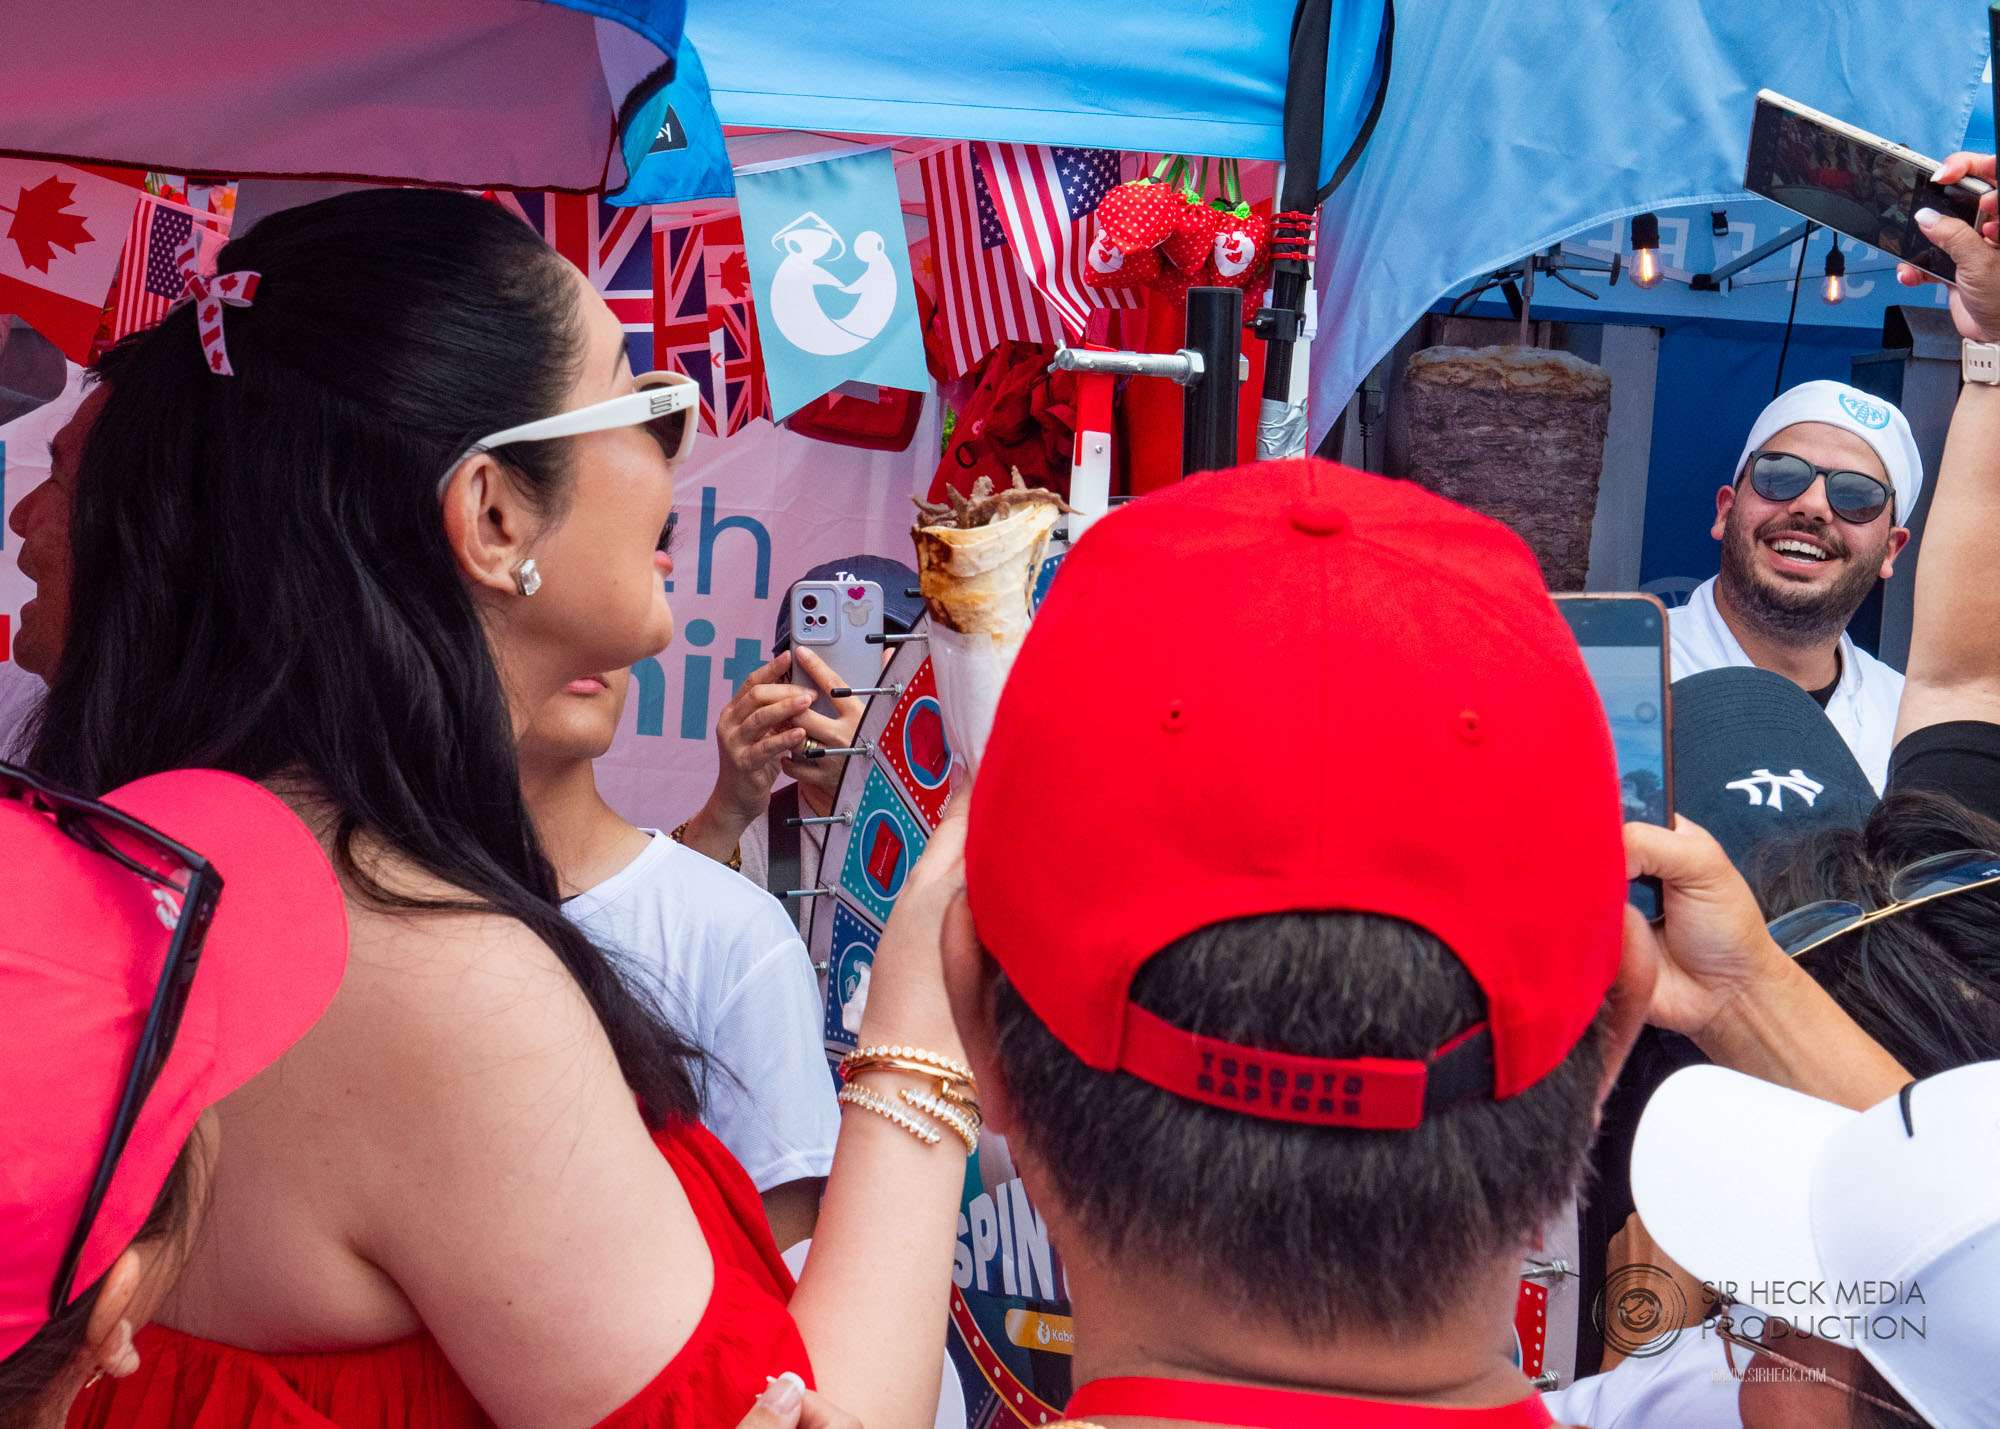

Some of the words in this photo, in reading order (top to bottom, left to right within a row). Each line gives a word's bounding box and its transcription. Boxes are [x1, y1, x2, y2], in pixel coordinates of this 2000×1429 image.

[1197, 1075, 1361, 1115] RAPTORS
[1202, 1053, 1362, 1095] TORONTO
[952, 1177, 1055, 1301] SPIN
